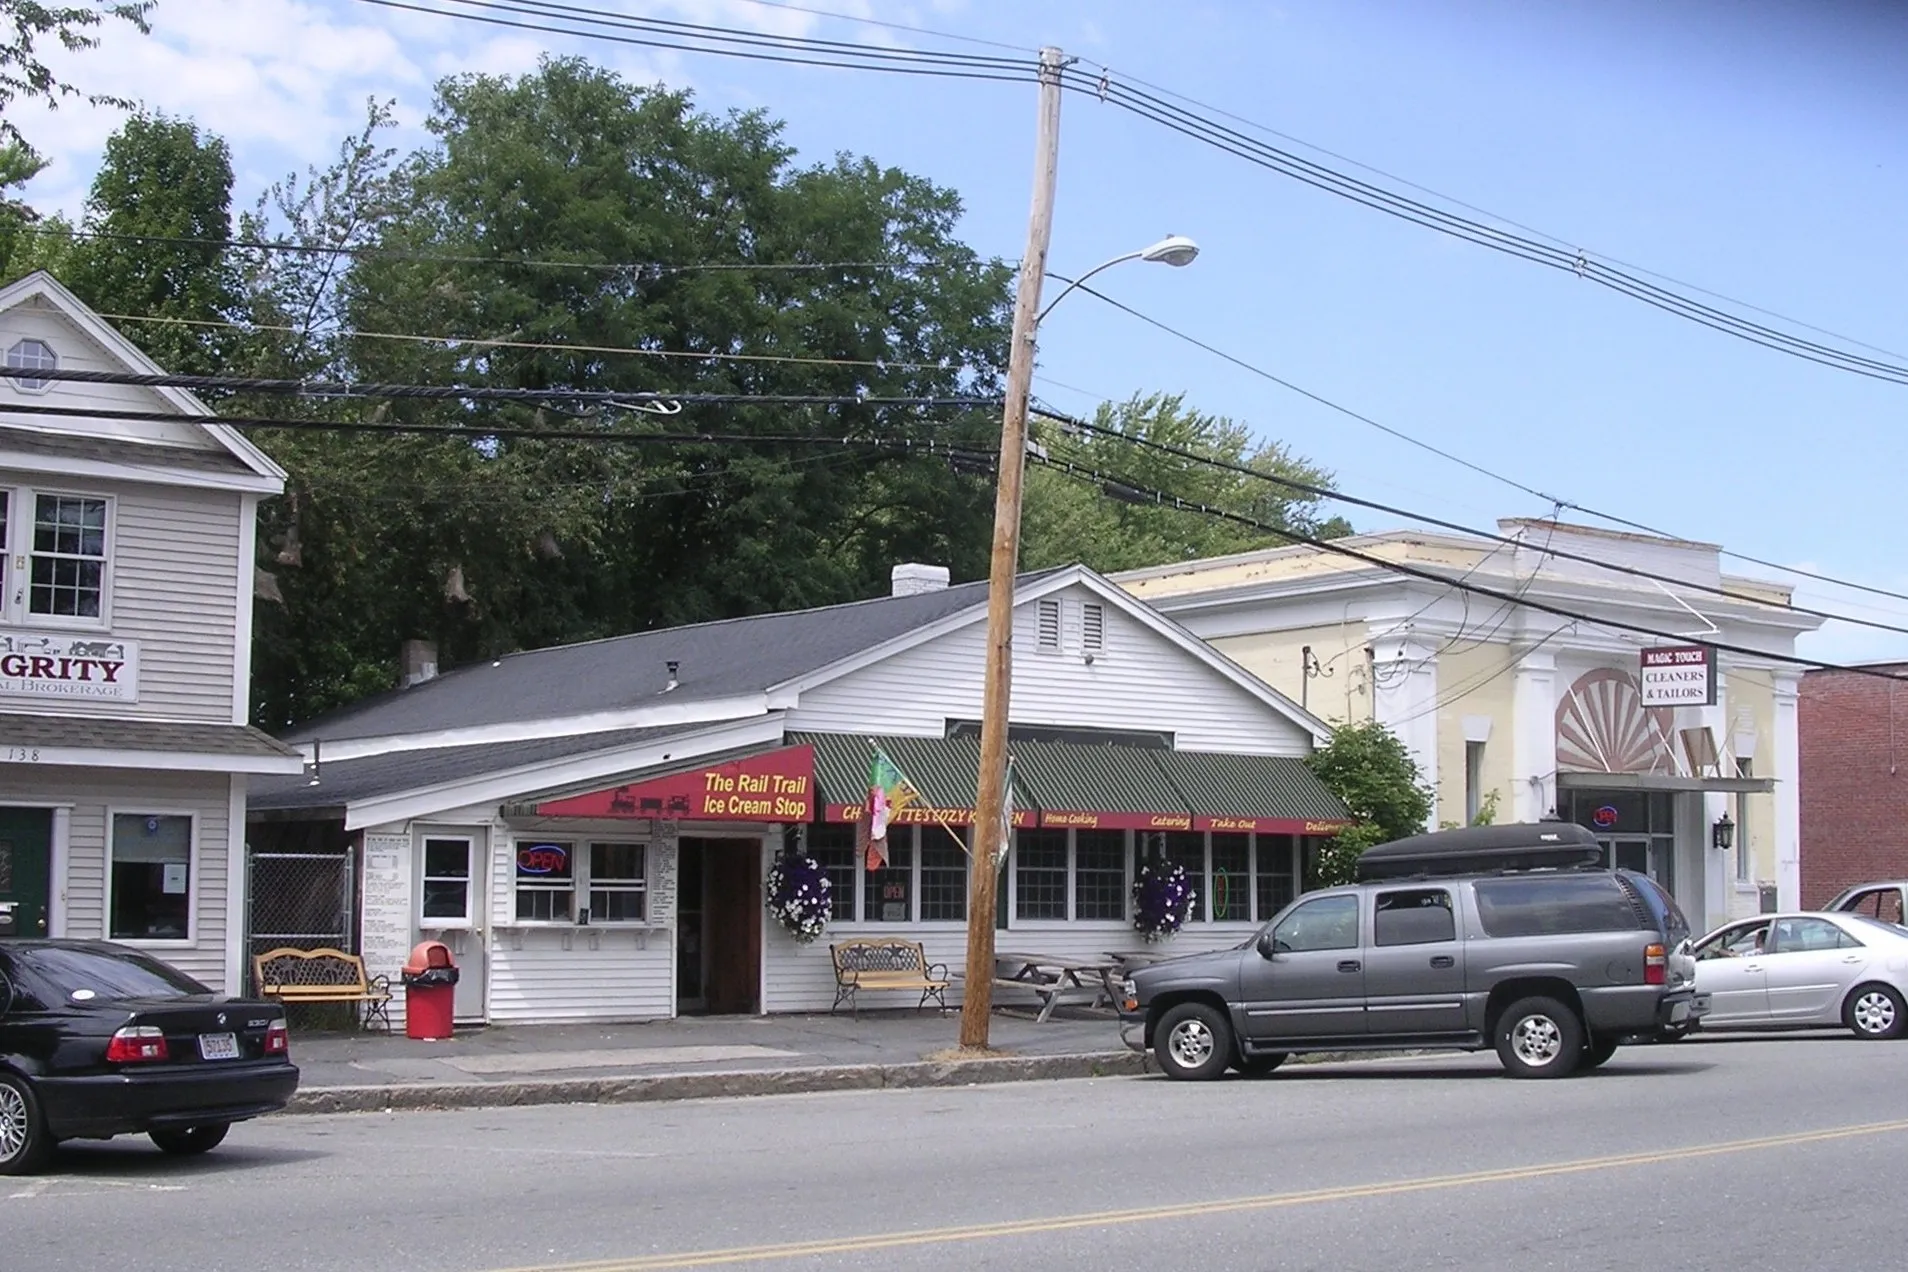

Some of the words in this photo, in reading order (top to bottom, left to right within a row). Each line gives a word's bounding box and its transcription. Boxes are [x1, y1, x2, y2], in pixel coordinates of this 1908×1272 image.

[1647, 653, 1673, 664] MAGIC
[1675, 651, 1702, 663] TOUCH
[1645, 671, 1704, 683] CLEANERS
[1646, 689, 1654, 699] &
[1657, 687, 1704, 699] TAILORS
[705, 773, 734, 792] The
[738, 774, 768, 793] Rail
[773, 775, 806, 795] Trail
[704, 795, 725, 813] Ice
[728, 796, 772, 815] Cream
[775, 797, 806, 819] Stop
[842, 805, 931, 822] CHTTE'S
[1044, 813, 1067, 824] Home
[1068, 812, 1098, 828] Cooking
[1151, 815, 1191, 830] Catering
[1210, 818, 1235, 828] Take
[1238, 819, 1256, 829] Out
[518, 850, 565, 872] OPEN
